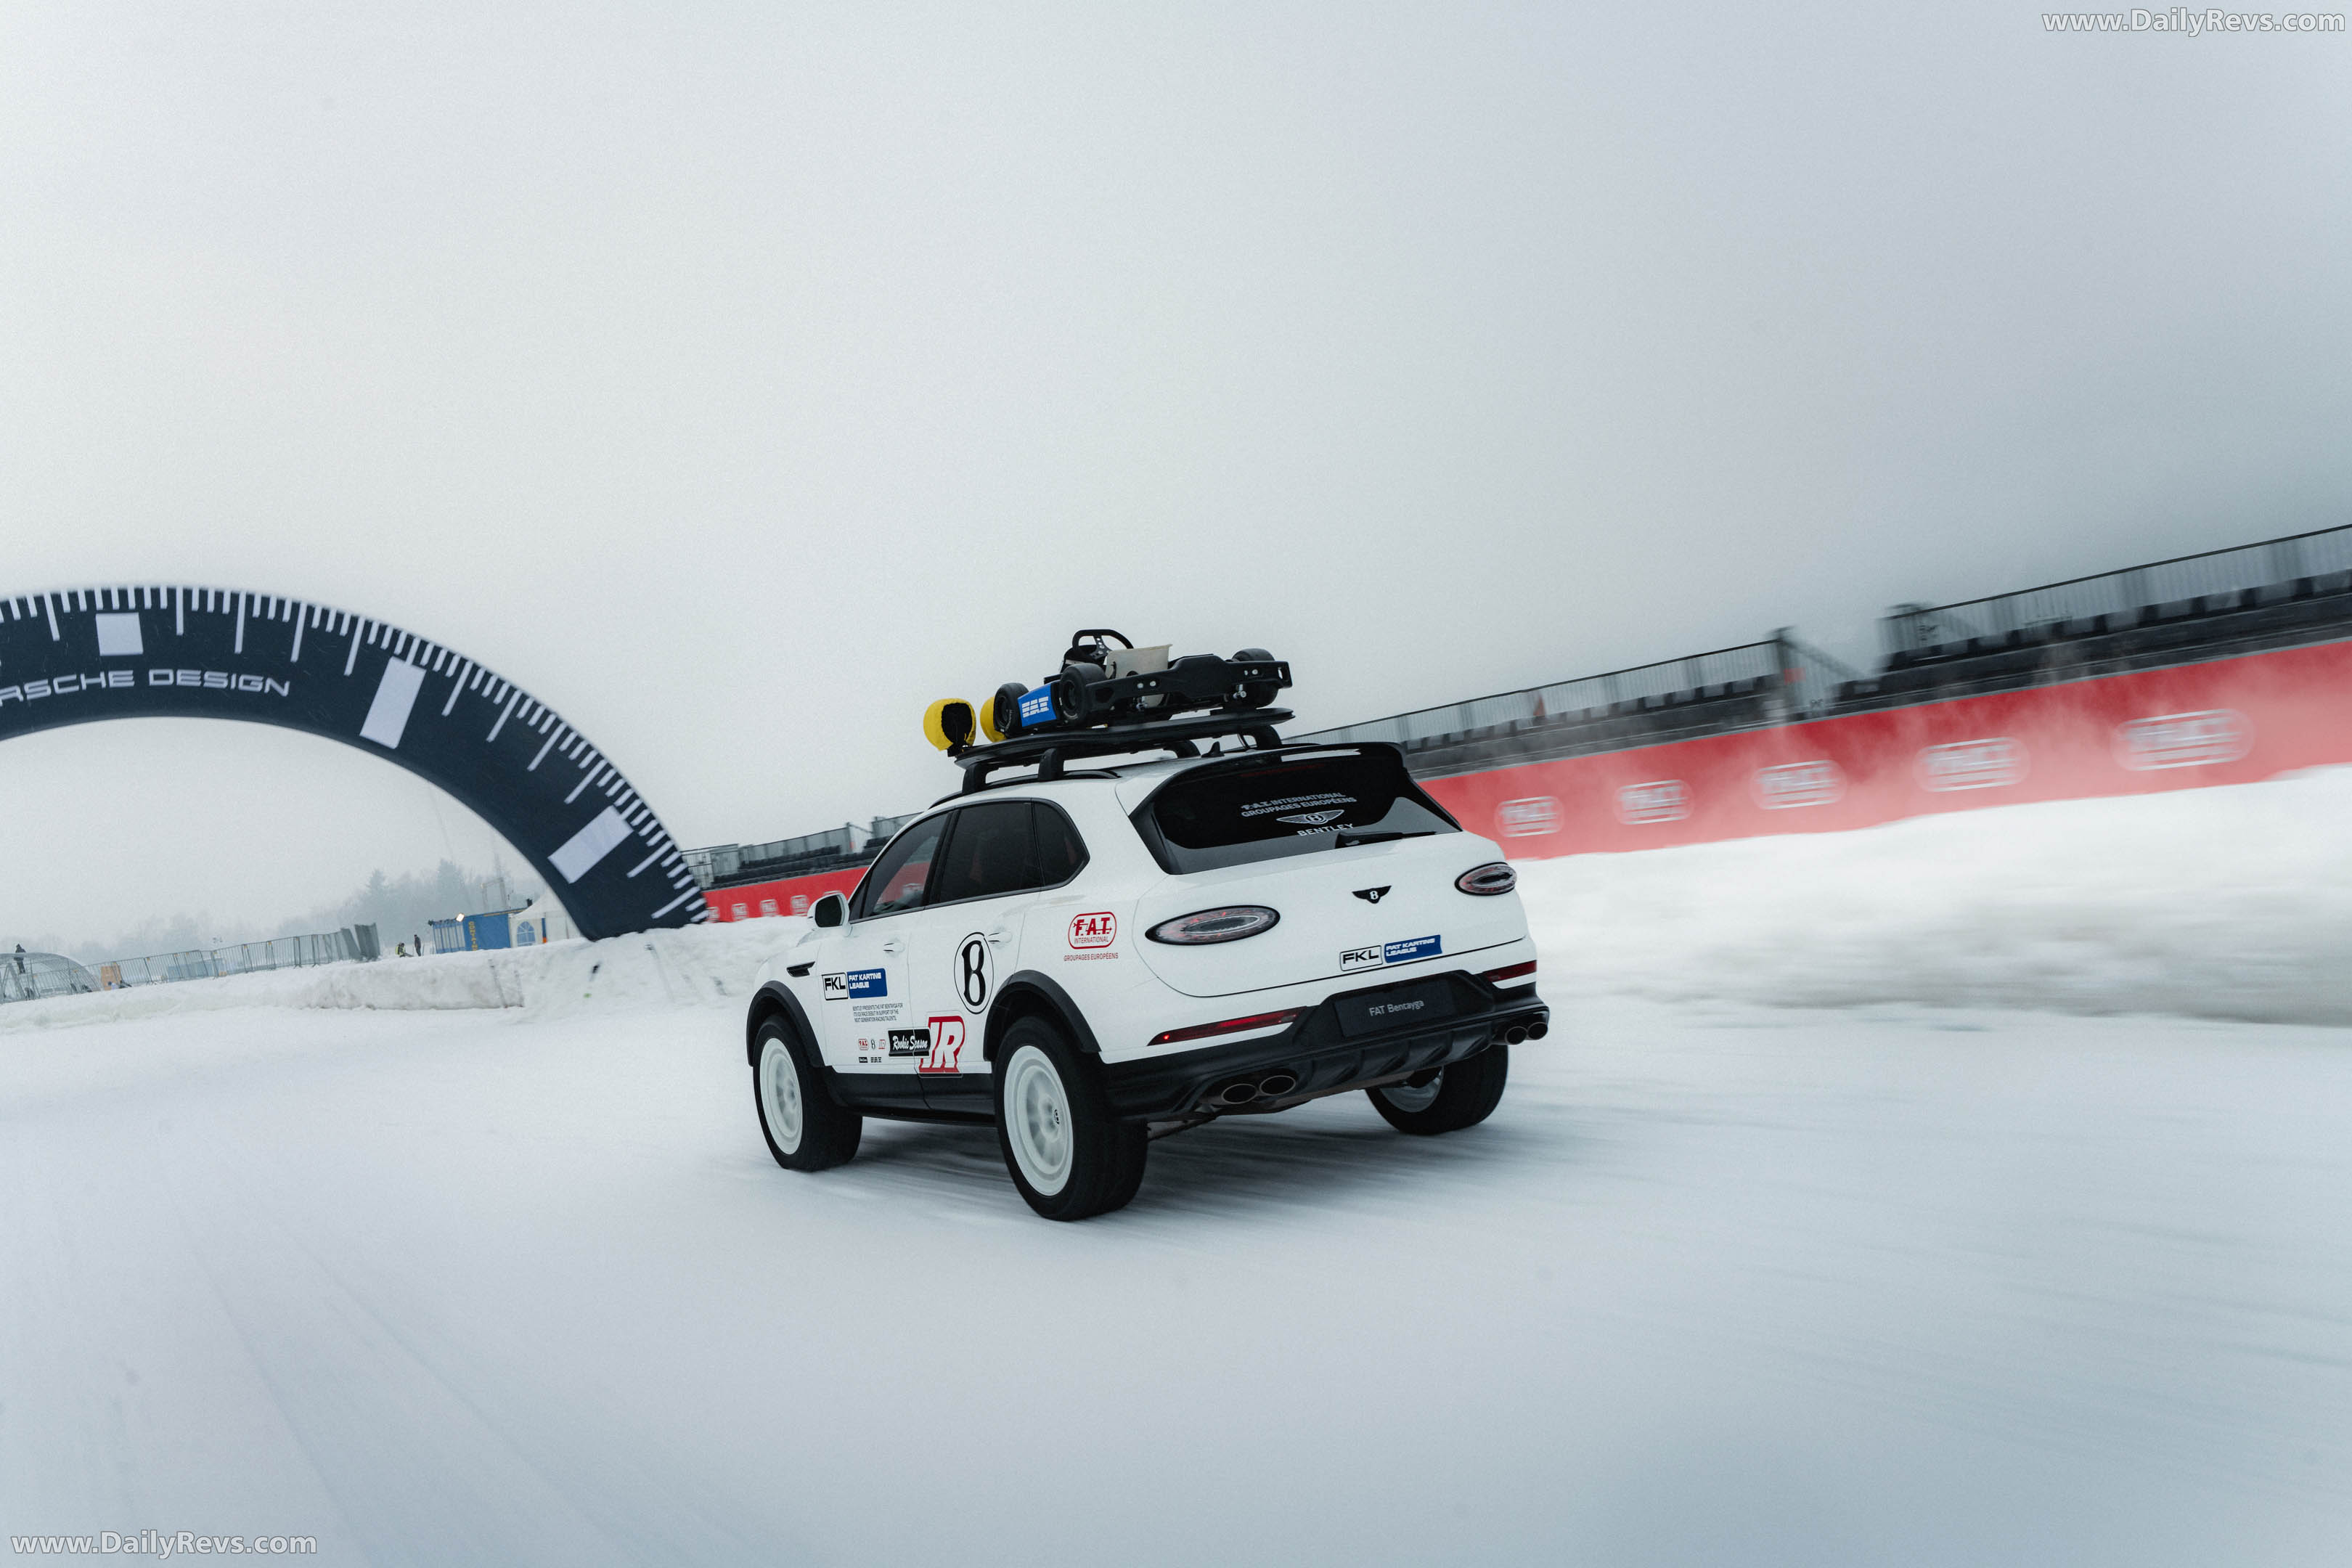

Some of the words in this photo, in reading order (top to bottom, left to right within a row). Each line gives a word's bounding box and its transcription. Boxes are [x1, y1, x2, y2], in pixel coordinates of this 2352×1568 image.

[148, 669, 290, 698] DESIGN
[1270, 792, 1345, 804] INTERNATIONAL
[1241, 803, 1301, 817] GROUPAGES
[1297, 823, 1354, 836] BENTLEY
[1402, 938, 1435, 947] KARTING
[1342, 950, 1379, 964] FKL
[1386, 947, 1417, 957] LEAGUE
[824, 976, 846, 991] FKL
[1369, 1005, 1385, 1016] FAT
[1387, 1000, 1424, 1013] Bentayga
[892, 1035, 909, 1050] Rookie
[910, 1035, 928, 1050] Season
